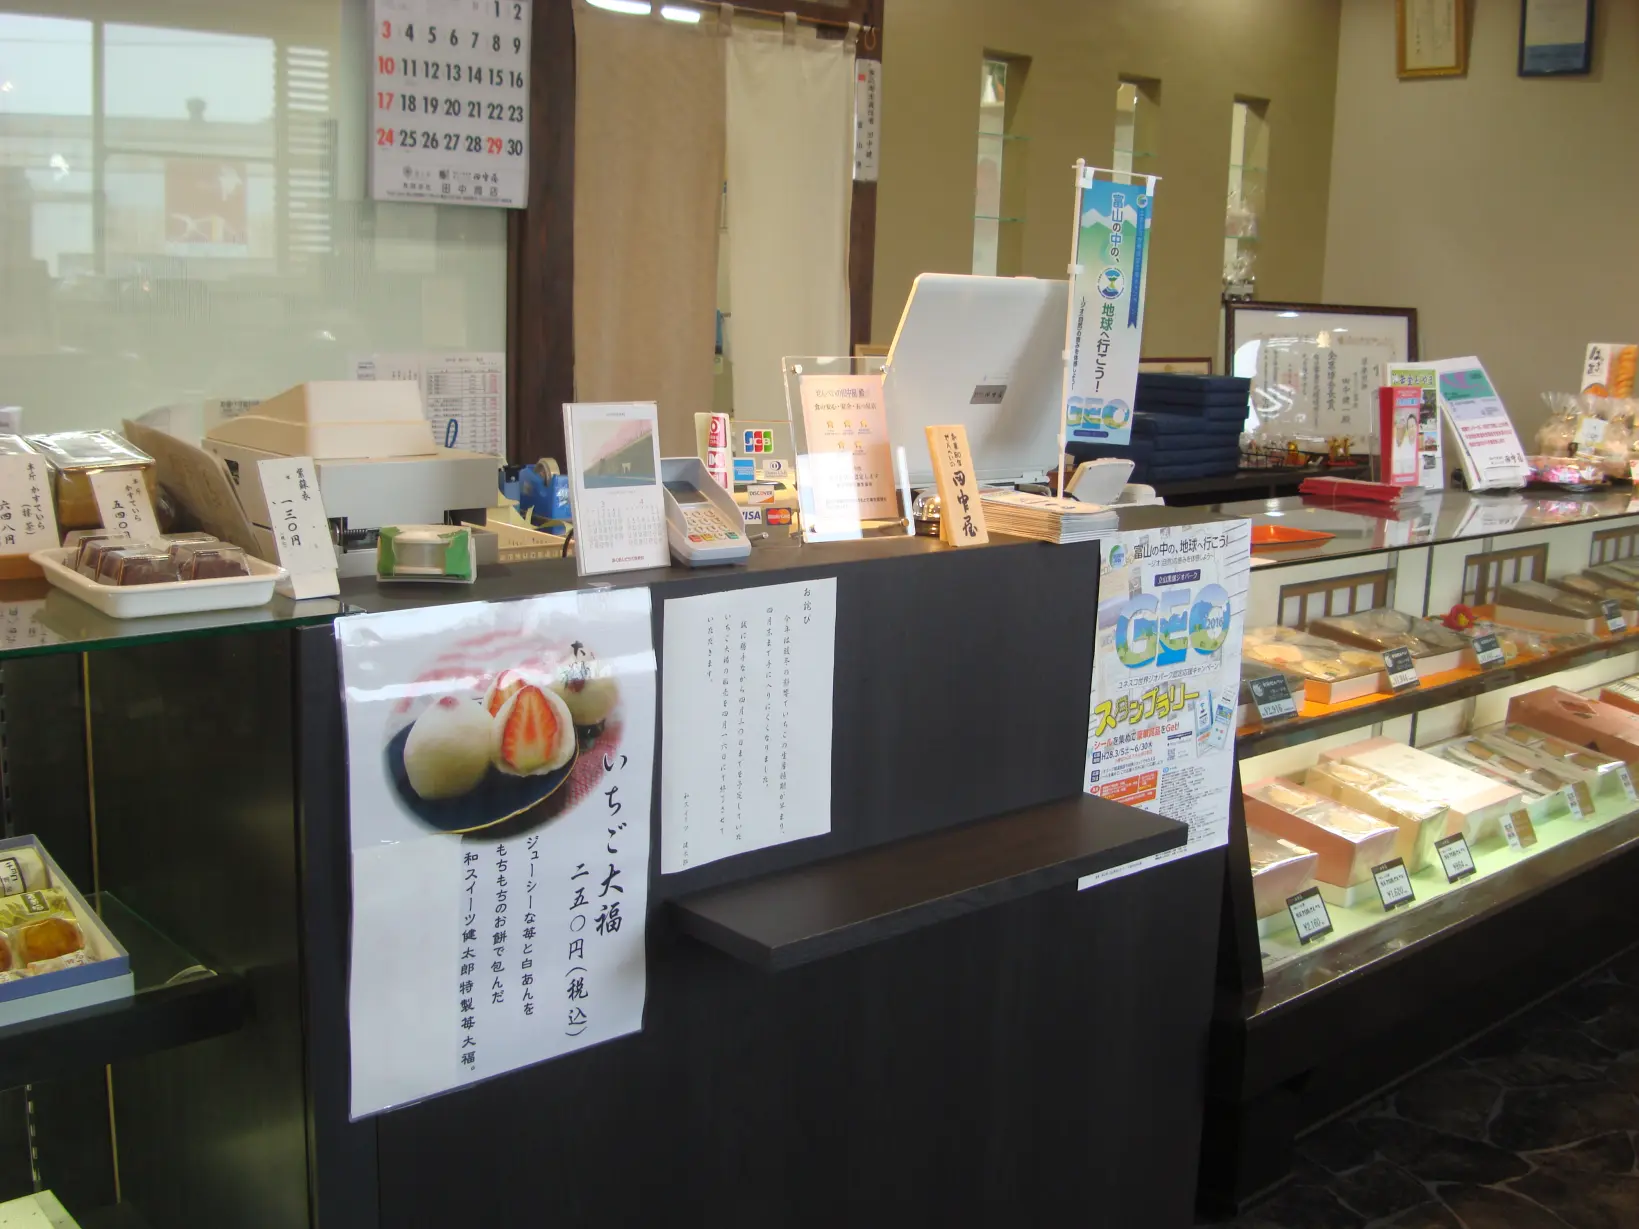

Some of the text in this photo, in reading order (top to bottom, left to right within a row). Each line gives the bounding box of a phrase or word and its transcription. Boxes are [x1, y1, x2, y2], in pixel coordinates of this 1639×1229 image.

[494, 0, 522, 20] 1 2
[382, 20, 521, 54] 3 4 5 6 7 8 9
[378, 56, 523, 88] 10 11 12 13 14 15 16
[377, 92, 523, 122] 17 18 19 20 21 22 23
[377, 128, 523, 156] 24 25 26 27 28 29 30
[1110, 192, 1125, 262] 富山の中の、
[1066, 396, 1130, 429] GEO
[281, 499, 301, 546] 一三〇円
[803, 587, 812, 625] お詫び
[1116, 583, 1231, 669] GEO
[1205, 618, 1225, 630] 2016
[1094, 682, 1200, 737] スタンプラリー
[594, 753, 628, 936] いちご大福
[490, 844, 508, 1005] もちもちのお餅で包んだ
[521, 835, 540, 1016] ジューシーな苺と白あんを
[459, 852, 479, 1071] 和スイーツ健太郎特製苺大福。
